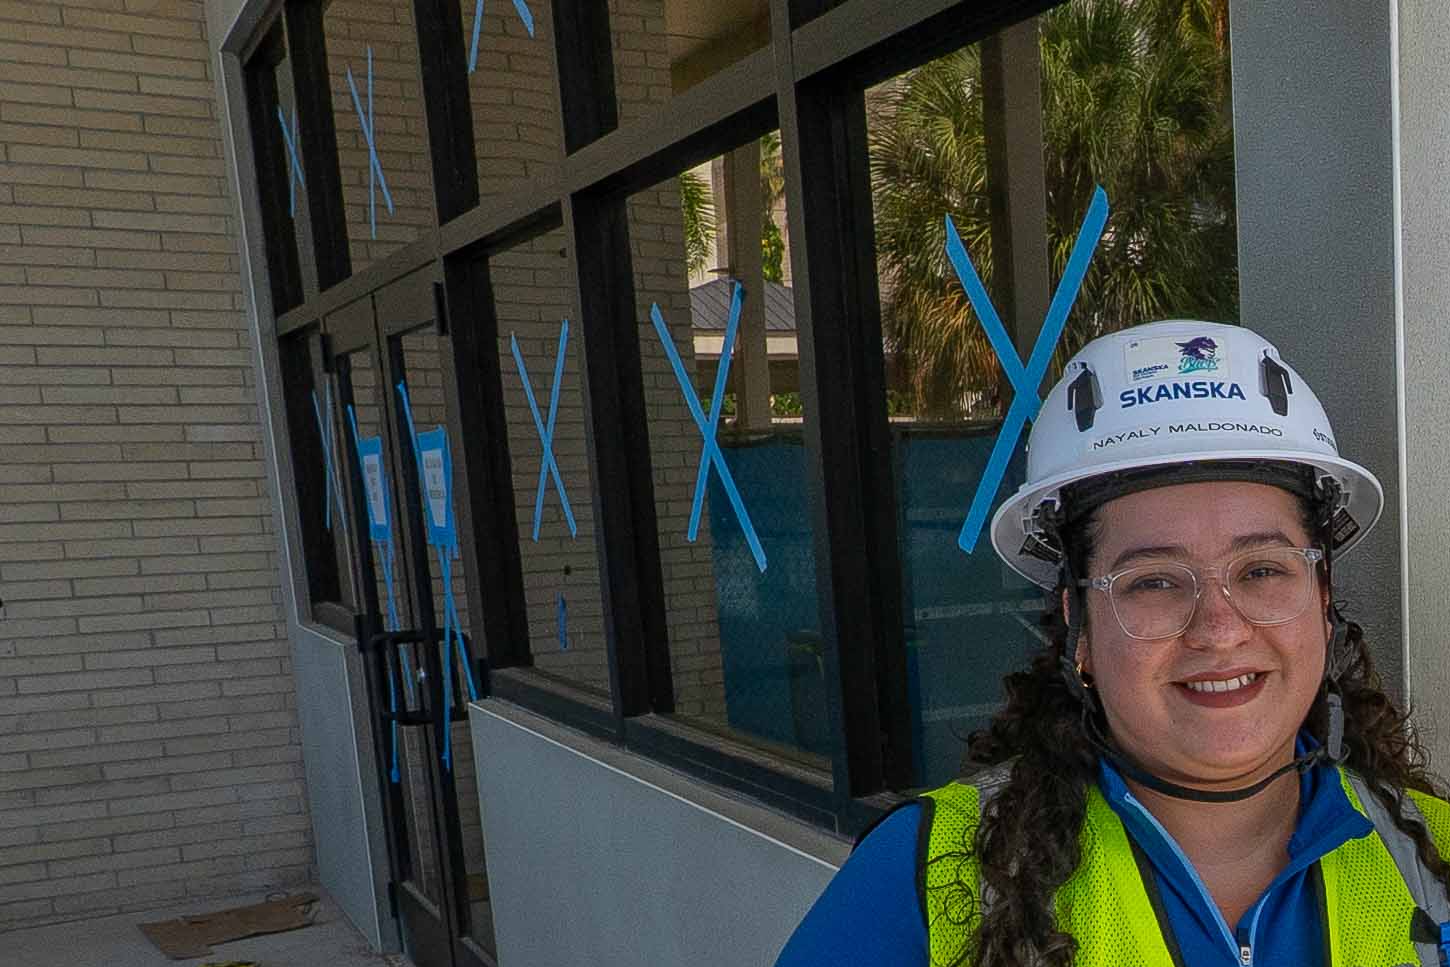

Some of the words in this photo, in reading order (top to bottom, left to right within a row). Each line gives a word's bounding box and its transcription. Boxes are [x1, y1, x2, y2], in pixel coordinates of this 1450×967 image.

[1119, 381, 1247, 409] SKANSKA
[1093, 427, 1161, 451] NAYALY
[1168, 422, 1283, 437] MALDONADO
